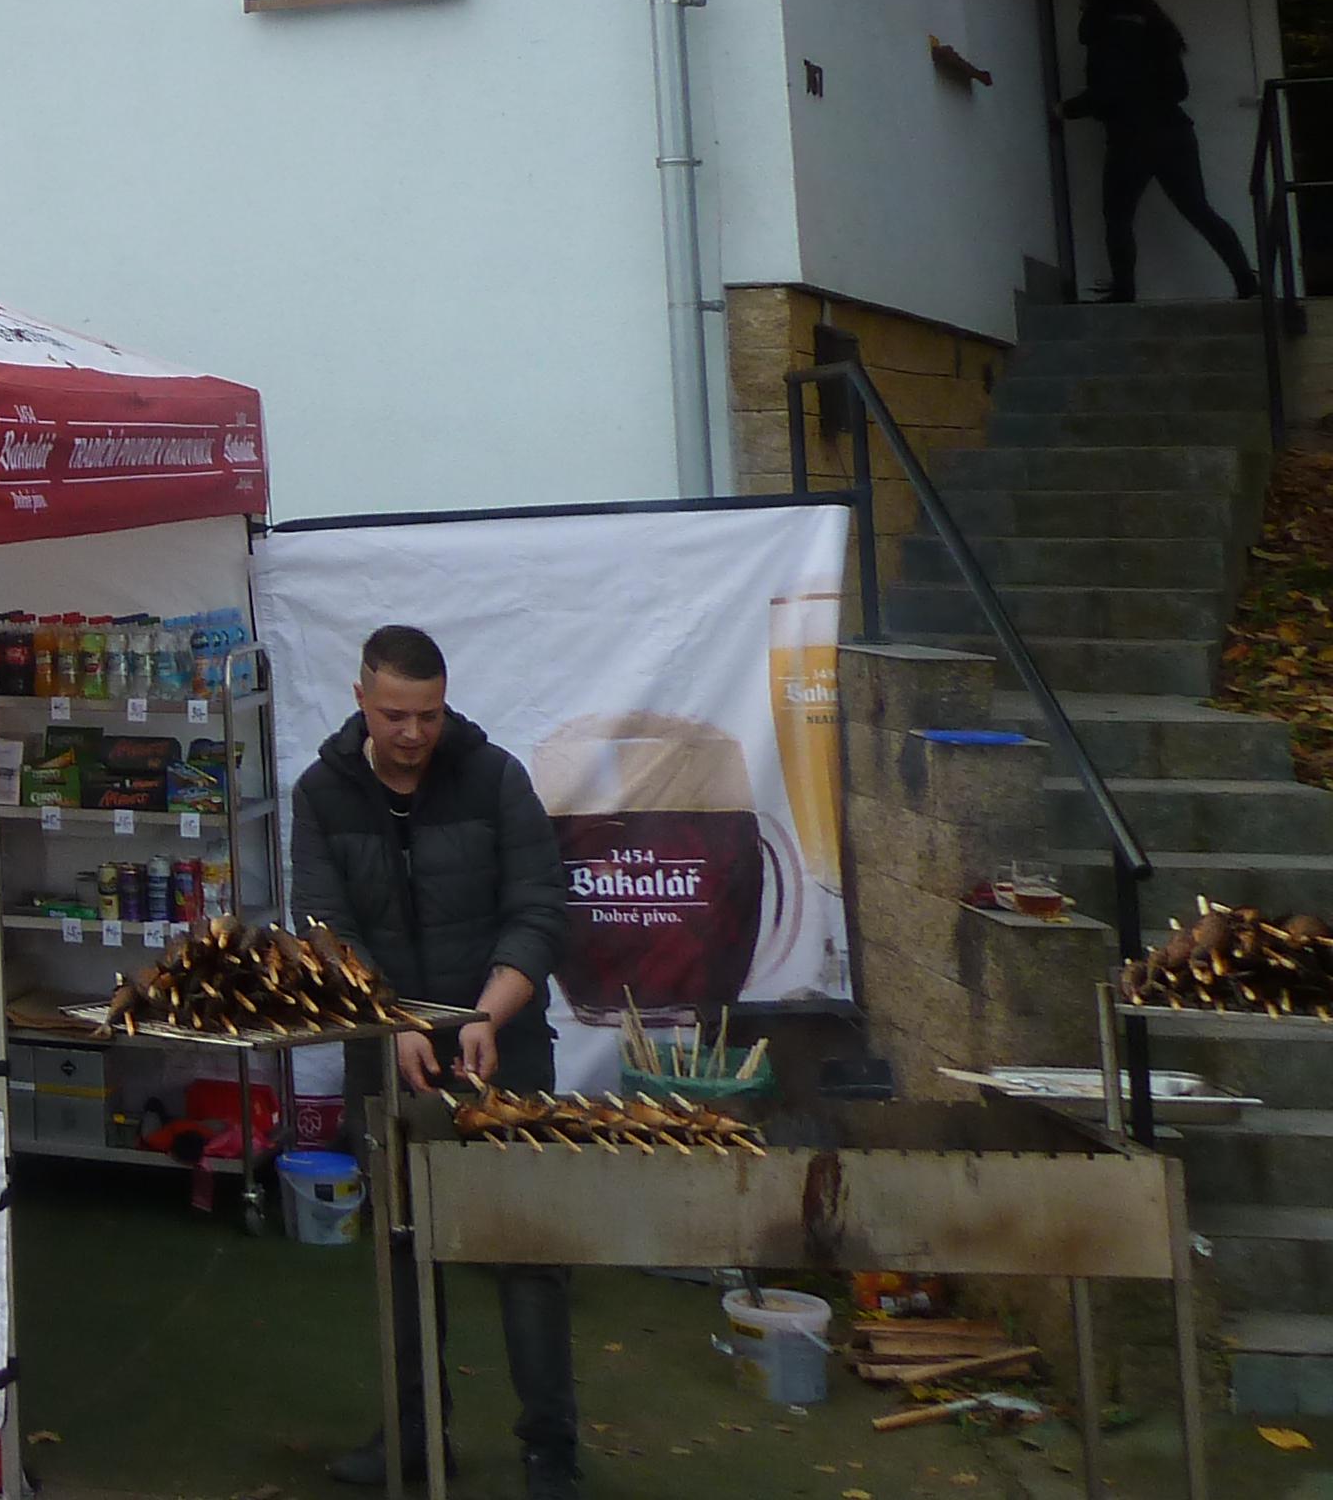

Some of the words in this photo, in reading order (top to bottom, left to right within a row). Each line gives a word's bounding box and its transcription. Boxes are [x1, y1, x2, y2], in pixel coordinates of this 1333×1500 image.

[611, 849, 655, 864] 1454
[568, 867, 702, 896] Bakalář
[592, 908, 640, 922] Dobré
[643, 908, 683, 926] pivo.
